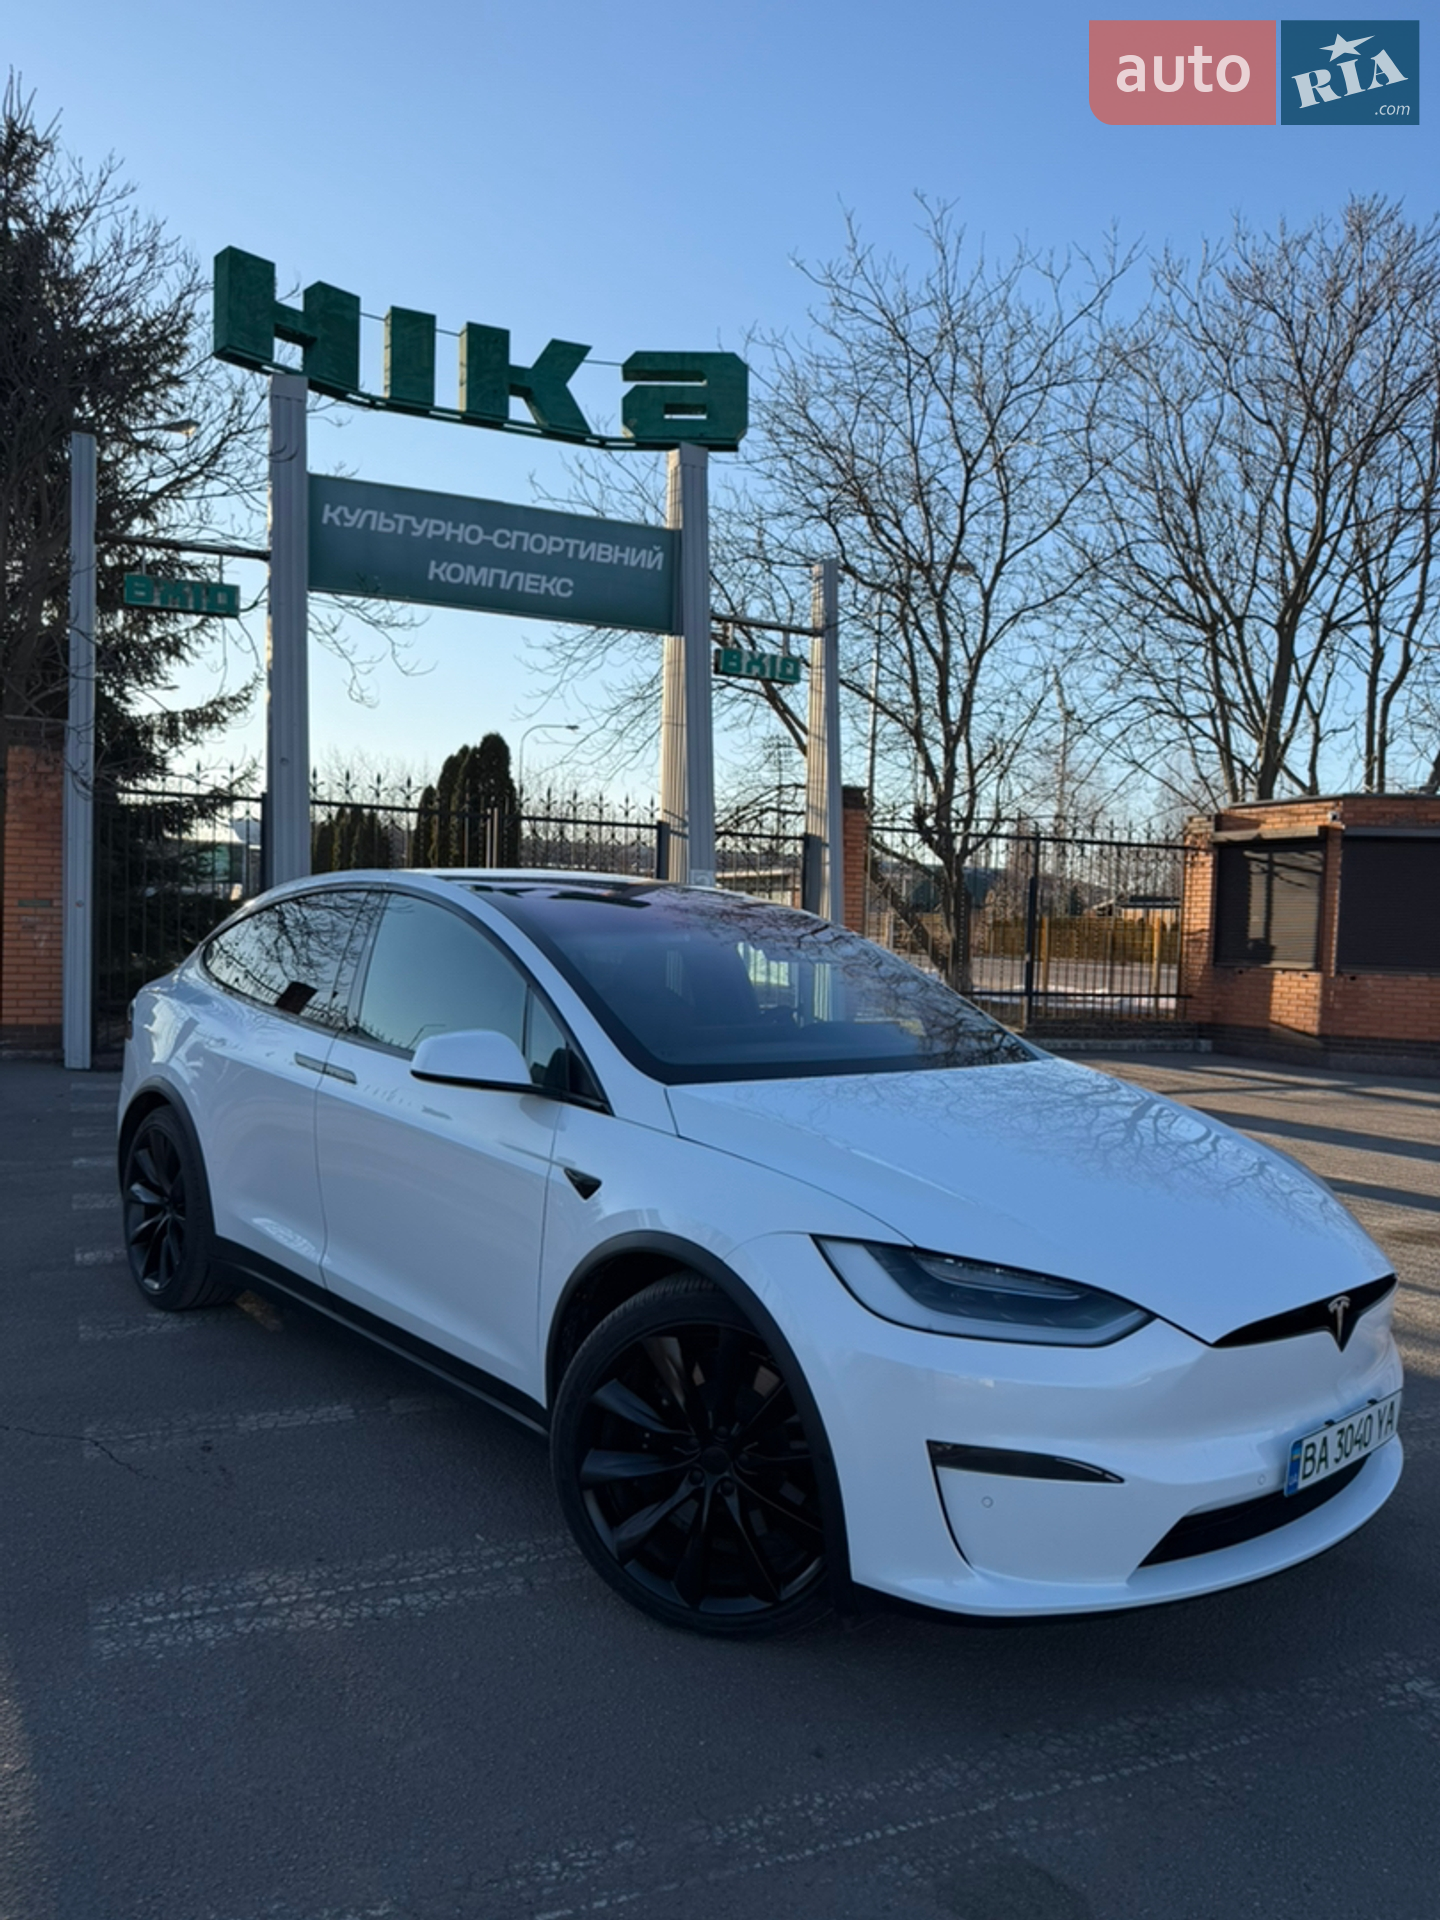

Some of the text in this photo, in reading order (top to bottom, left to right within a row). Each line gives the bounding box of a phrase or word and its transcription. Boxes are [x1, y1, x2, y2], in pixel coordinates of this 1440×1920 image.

[321, 503, 665, 571] КУЛЬТУРНО-СПОРТИВНИЙ
[428, 559, 575, 598] КОМПЛЕКС
[1302, 1436, 1329, 1480] BA
[1334, 1414, 1373, 1464] 3040
